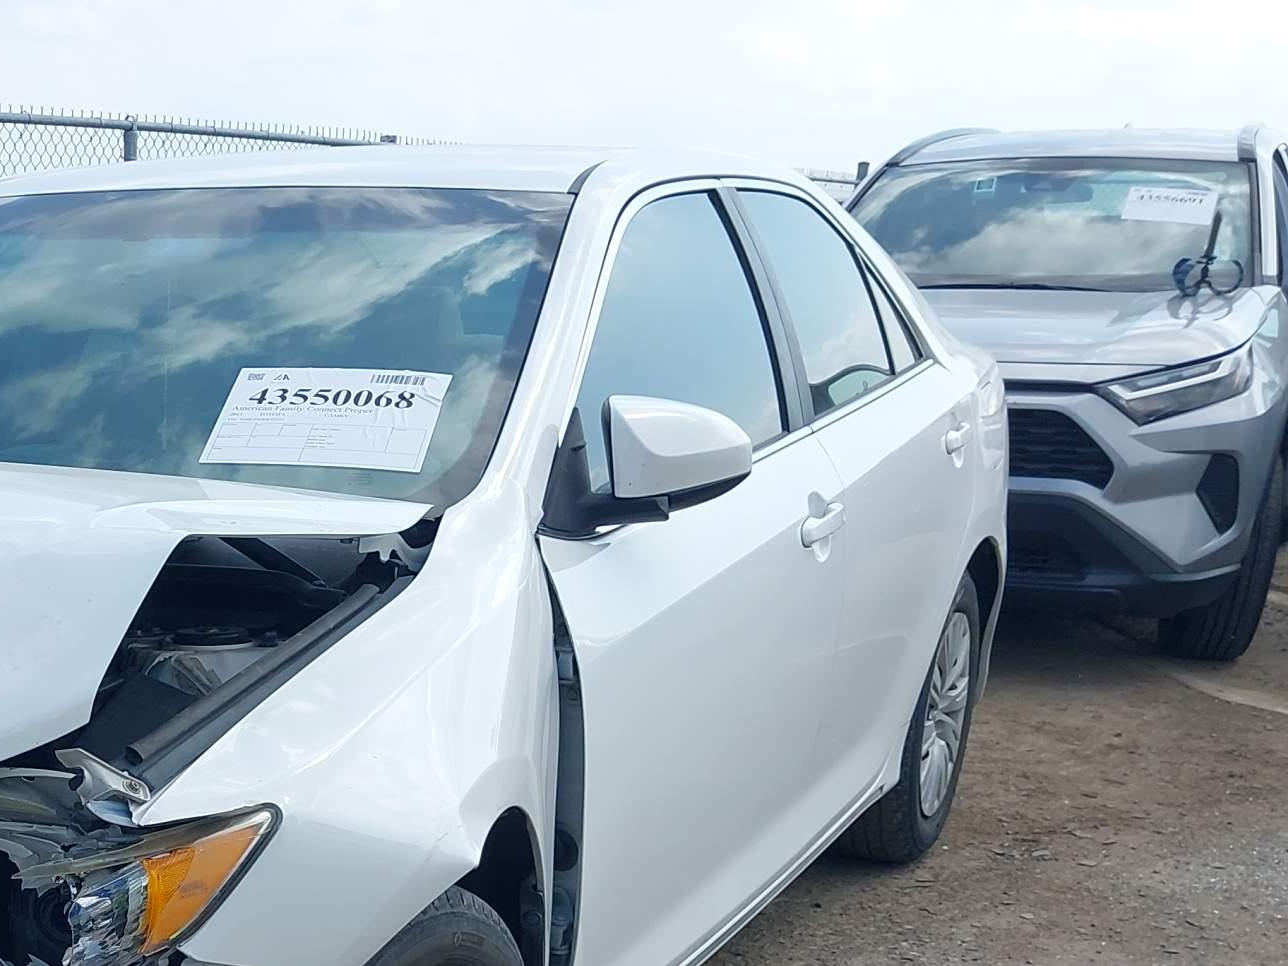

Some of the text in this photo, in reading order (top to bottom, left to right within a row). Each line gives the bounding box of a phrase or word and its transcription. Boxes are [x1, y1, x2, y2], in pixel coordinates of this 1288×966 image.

[248, 387, 416, 409] 43550068
[275, 405, 304, 413] Family
[344, 407, 373, 415] Proper
